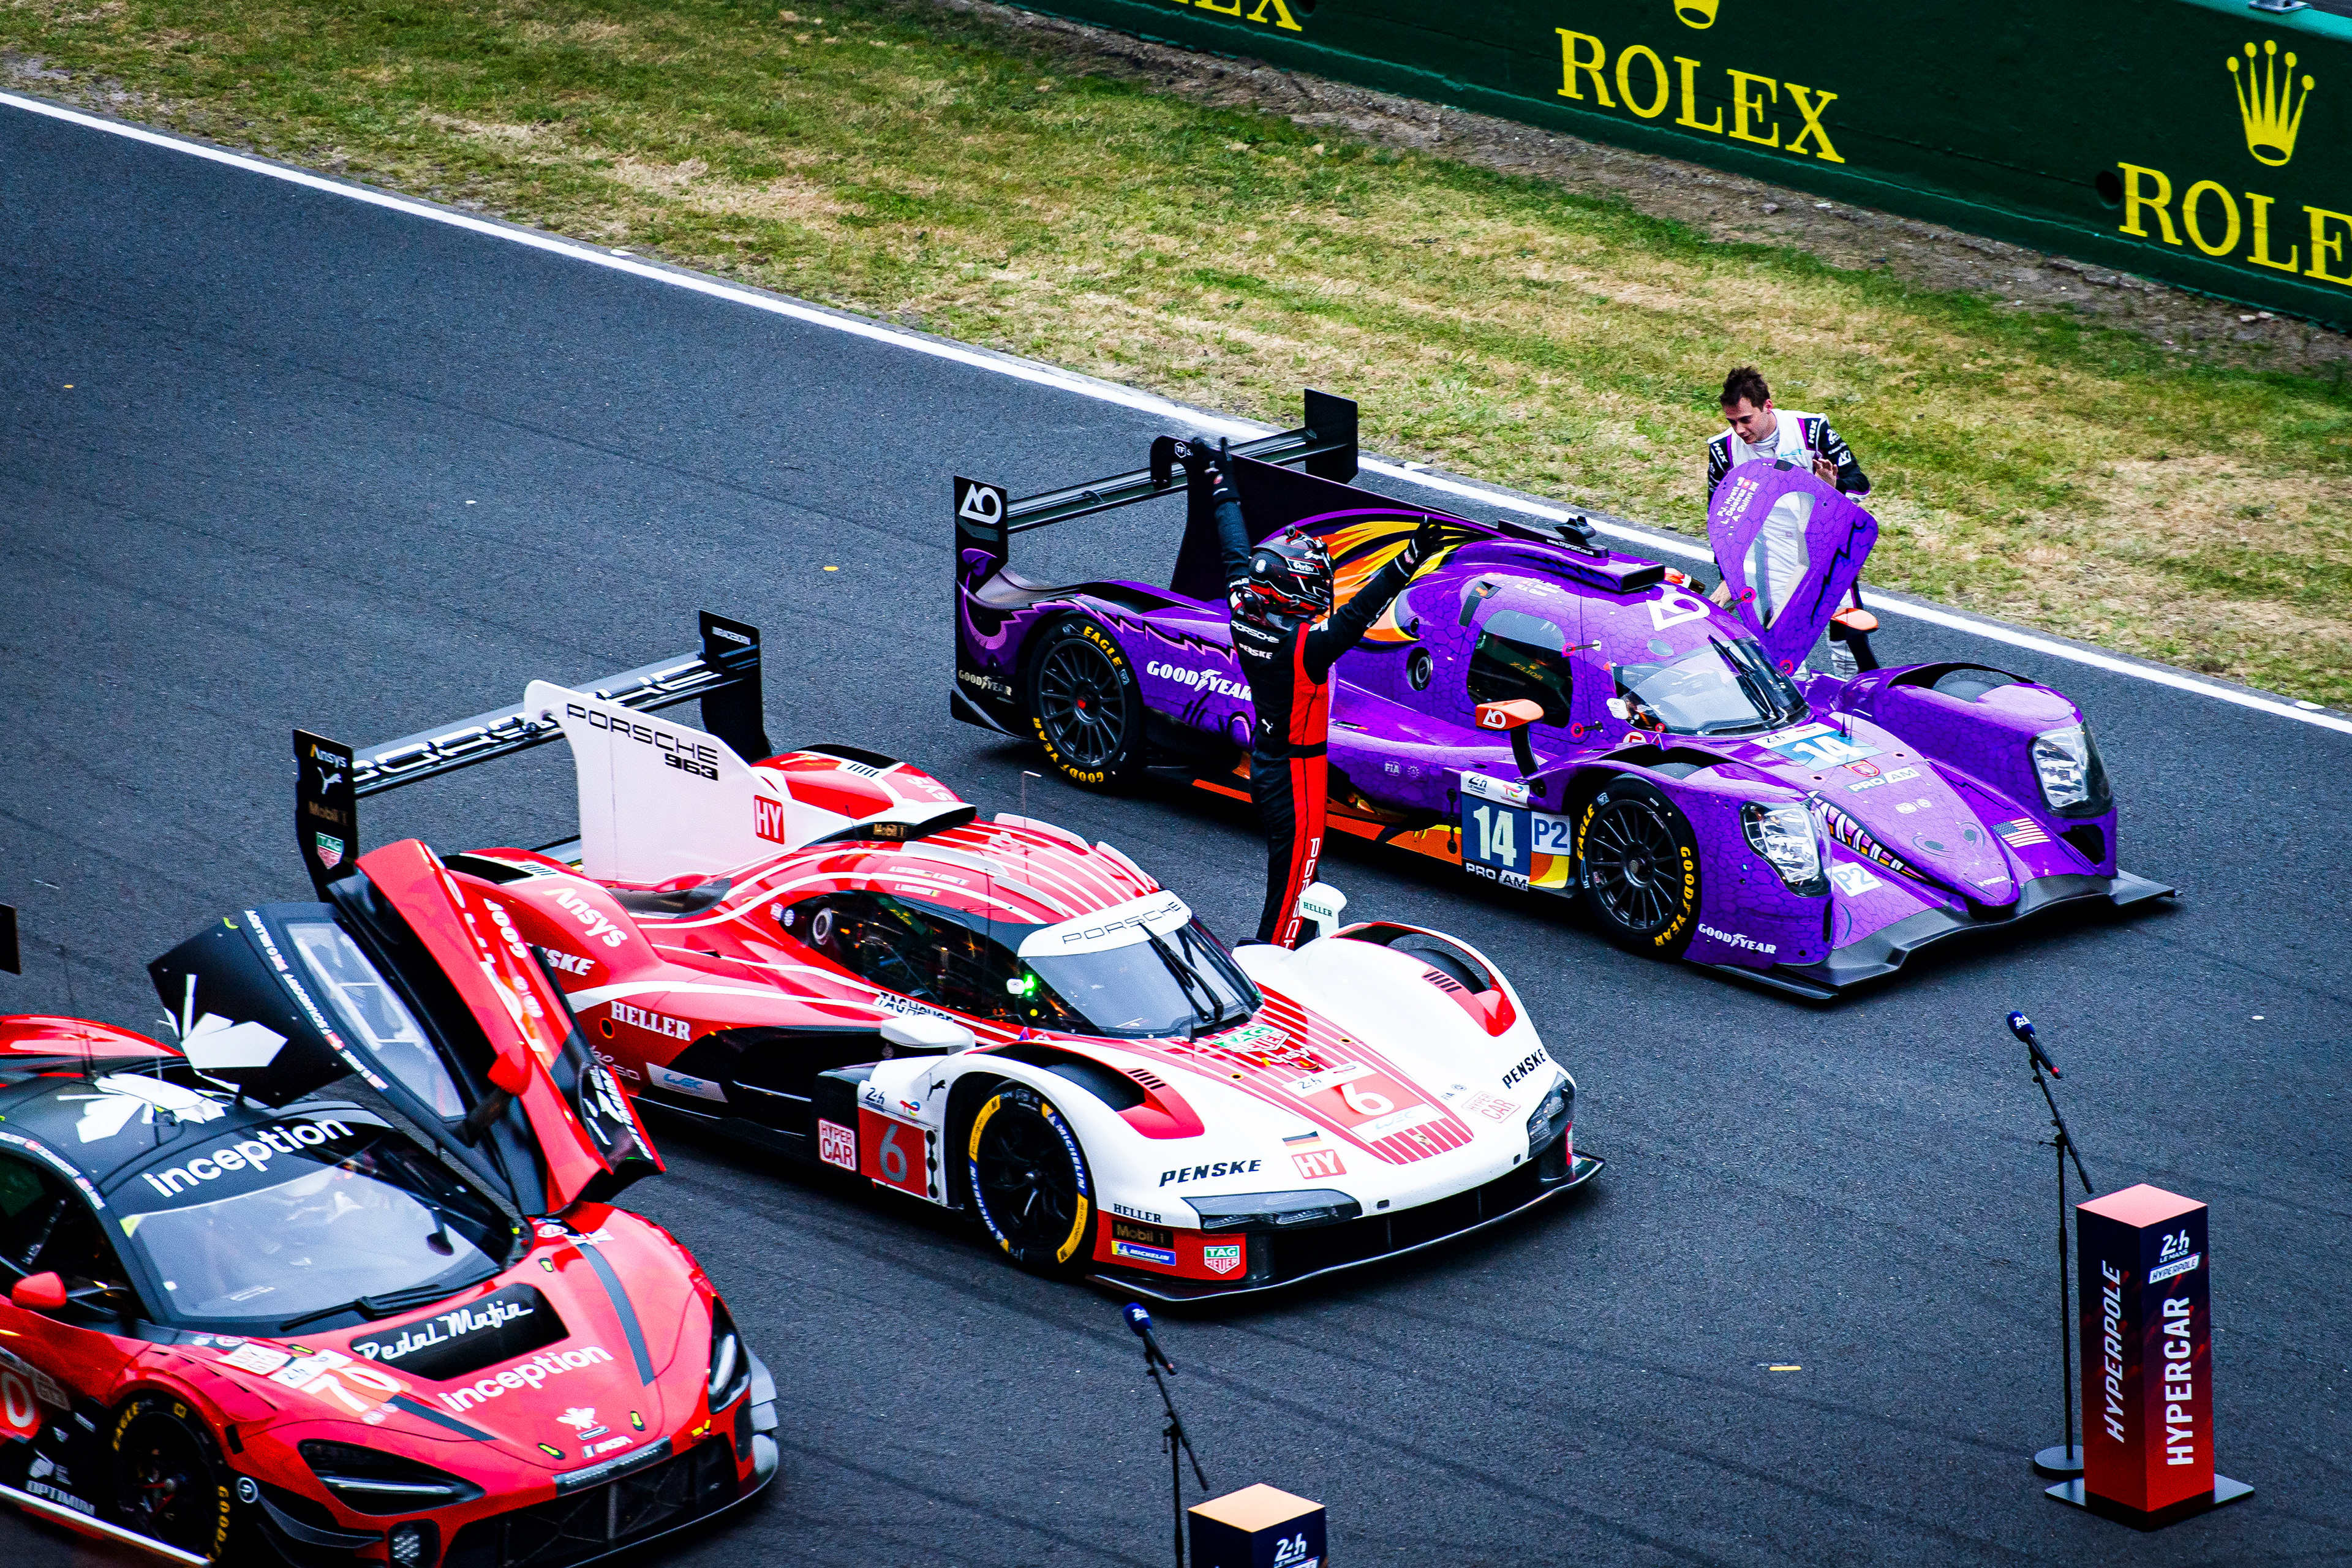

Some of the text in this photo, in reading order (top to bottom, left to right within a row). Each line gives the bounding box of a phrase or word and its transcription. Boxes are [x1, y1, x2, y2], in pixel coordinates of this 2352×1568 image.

[1556, 28, 1845, 163] ROLEX
[1231, 620, 1280, 643] PORSCHE
[1083, 626, 1123, 667] EAGLE
[567, 703, 718, 766] PORSCHE
[310, 744, 347, 768] Ansys
[1792, 735, 1865, 764] 14
[665, 752, 719, 782] 963
[1847, 769, 1917, 792] PRO AM
[756, 802, 782, 840] HY
[1534, 818, 1568, 848] P2
[1577, 804, 1595, 861] EAGLE
[1473, 805, 1517, 867] 14
[1466, 862, 1528, 889] PRO AM
[1832, 866, 1874, 891] P2
[542, 888, 628, 948] Ansys
[1061, 900, 1182, 944] PORSCHE
[1303, 902, 1333, 918] HELLER
[1698, 922, 1776, 955] GOODYEAR
[545, 948, 595, 976] SKE
[610, 1000, 692, 1041] HELLER
[1218, 1025, 1273, 1047] TAG
[1231, 1031, 1286, 1051] HEUER
[1261, 1045, 1319, 1066] Ansys
[1502, 1049, 1547, 1089] PENSKE
[1341, 1083, 1395, 1116] 6
[1466, 1093, 1494, 1111] HYPER
[1481, 1099, 1515, 1120] CAR
[821, 1124, 852, 1144] HYPER
[140, 1118, 355, 1199] inception
[822, 1138, 853, 1167] CAR
[880, 1123, 907, 1182] 6
[1055, 1123, 1085, 1189] MICHELIN
[1301, 1150, 1343, 1177] HY
[1159, 1159, 1262, 1187] PENSKE
[1114, 1203, 1162, 1224] HELLER
[1117, 1224, 1154, 1243] Mobil
[1129, 1248, 1170, 1261] MICHELIN
[1205, 1257, 1239, 1272] HEUER
[1207, 1247, 1237, 1256] TAG
[2152, 1258, 2196, 1281] HYPERPOLE
[353, 1323, 449, 1360] Pedal
[2102, 1260, 2125, 1443] HYPERPOLE
[300, 1366, 402, 1413] 70
[437, 1344, 614, 1412] inception
[2163, 1297, 2194, 1466] HYPERCAR
